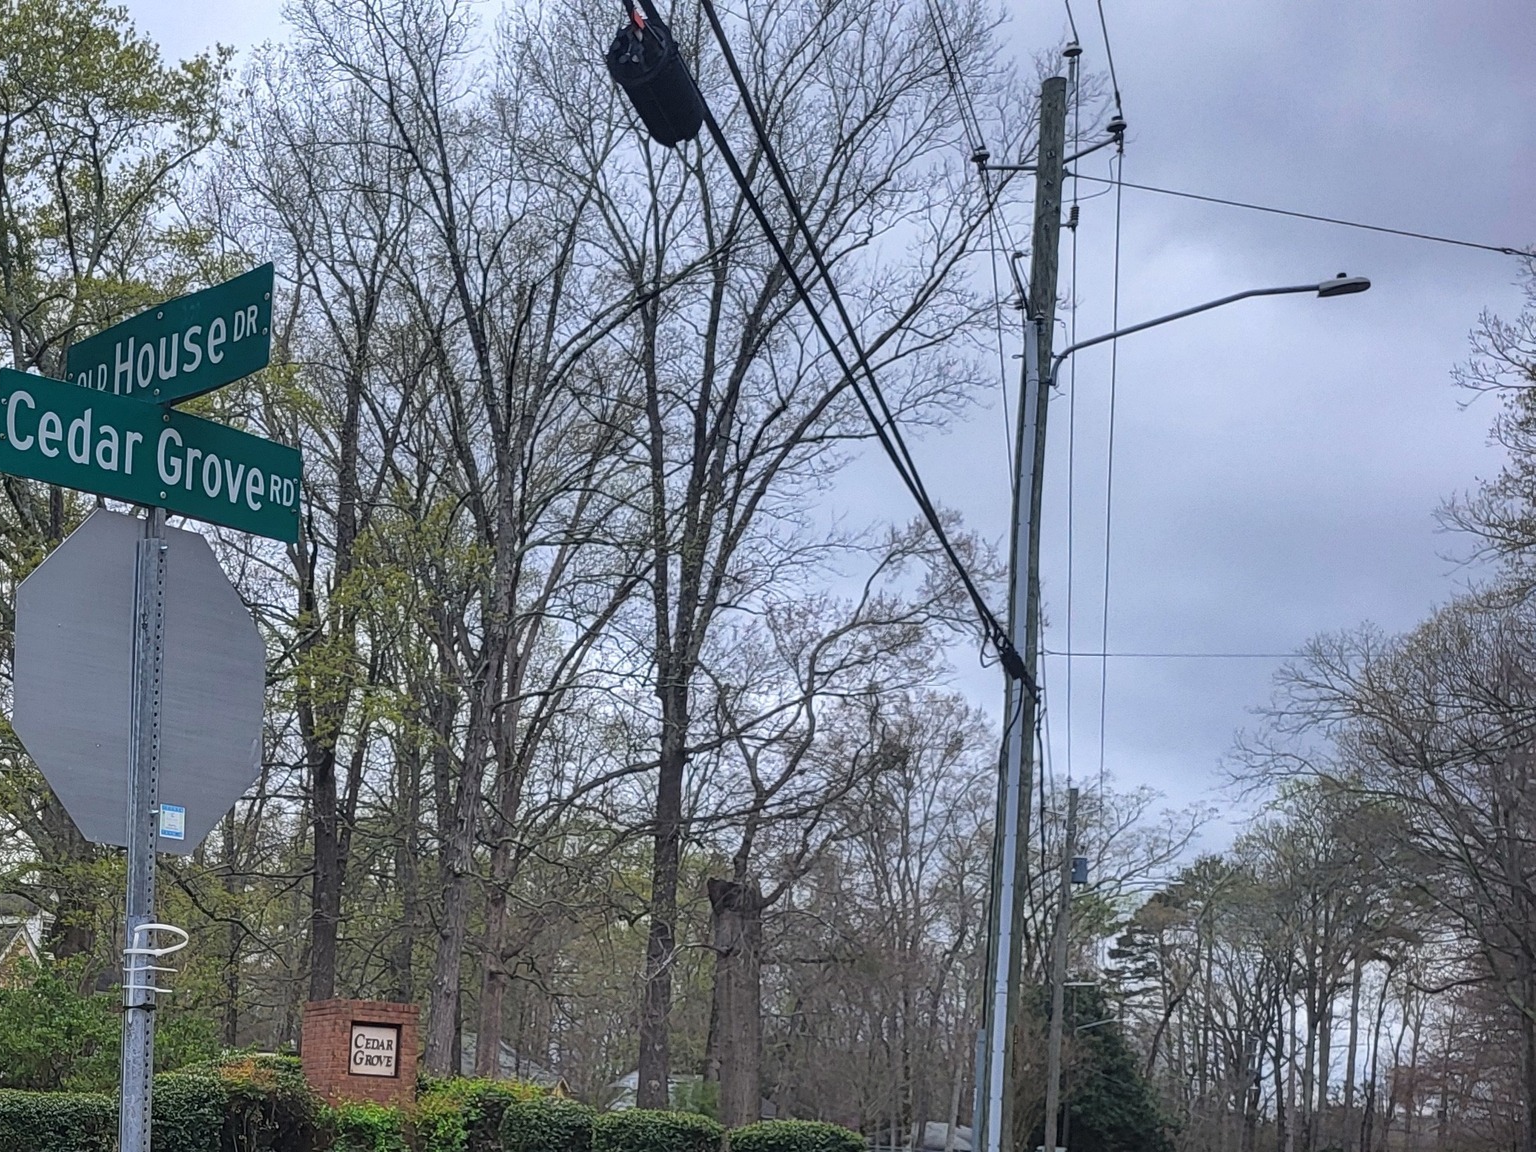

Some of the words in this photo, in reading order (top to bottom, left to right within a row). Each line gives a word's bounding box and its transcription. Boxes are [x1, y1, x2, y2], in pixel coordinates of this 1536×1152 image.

[114, 317, 227, 395] House
[232, 304, 259, 343] DR
[6, 390, 143, 475] Cedar
[157, 427, 265, 512] Grove
[269, 475, 295, 507] RD
[353, 1050, 393, 1068] GROVE
[354, 1033, 394, 1051] CEDAR
